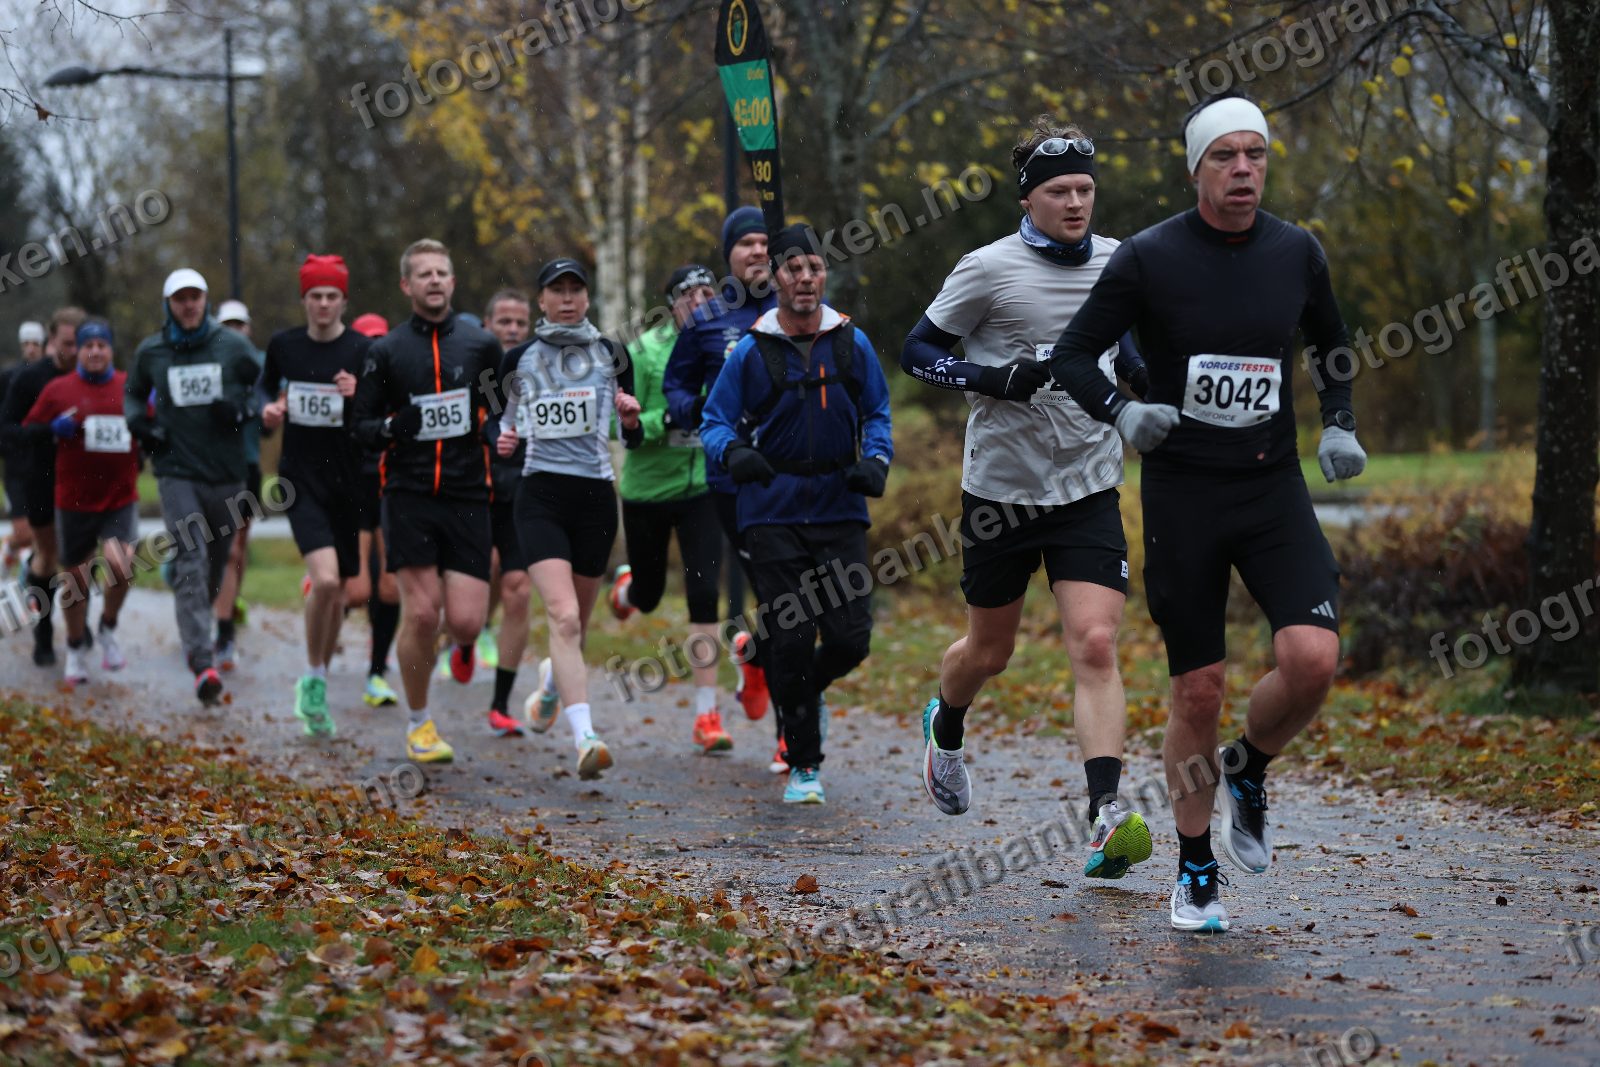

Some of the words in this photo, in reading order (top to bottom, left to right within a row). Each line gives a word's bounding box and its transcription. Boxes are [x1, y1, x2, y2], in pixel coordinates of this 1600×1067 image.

[1198, 361, 1275, 373] NORGESTESTEN
[179, 376, 212, 397] 562
[1194, 375, 1271, 411] 3042
[299, 395, 331, 417] 165
[425, 403, 462, 428] 385
[536, 400, 588, 426] 9361
